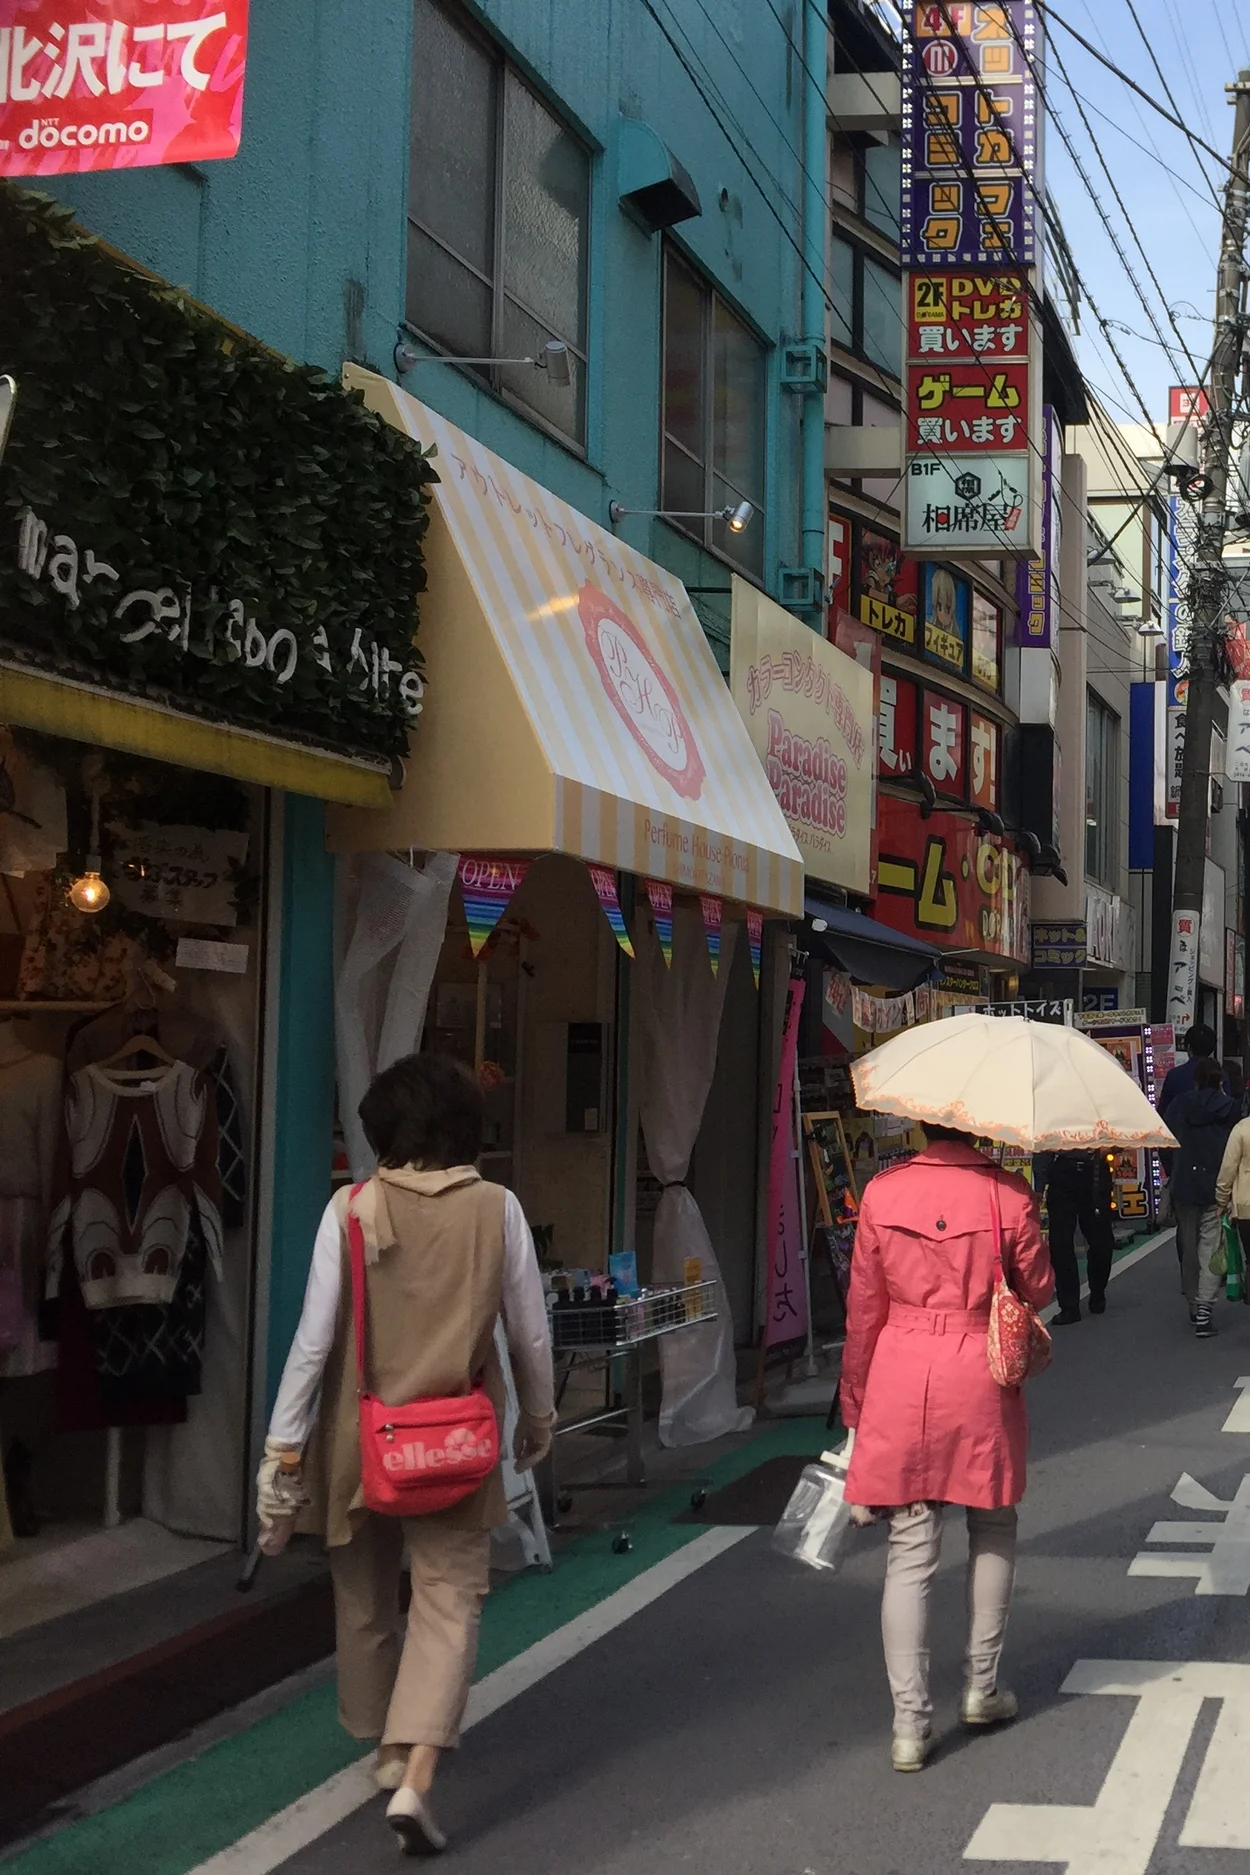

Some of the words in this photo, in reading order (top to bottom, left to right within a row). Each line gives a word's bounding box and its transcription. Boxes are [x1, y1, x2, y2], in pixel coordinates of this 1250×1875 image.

[923, 5, 966, 32] 4F
[18, 119, 149, 149] docomo
[40, 117, 60, 126] NTT
[916, 281, 945, 307] 2F
[951, 278, 1021, 297] DVD
[952, 299, 1023, 321] トレカ
[918, 323, 1023, 352] 買います
[918, 374, 1021, 409] ゲーム
[916, 414, 1022, 444] 買います
[911, 463, 941, 476] B1F
[921, 502, 1009, 534] 相席屋
[868, 609, 906, 637] トレカ
[767, 707, 848, 799] Paradise
[644, 819, 689, 854] Perfume
[691, 835, 722, 864] House
[461, 858, 521, 891] OPEN
[1034, 949, 1086, 965] コミック
[982, 1001, 1062, 1018] ホットトイズ
[382, 1437, 493, 1472] ellesse
